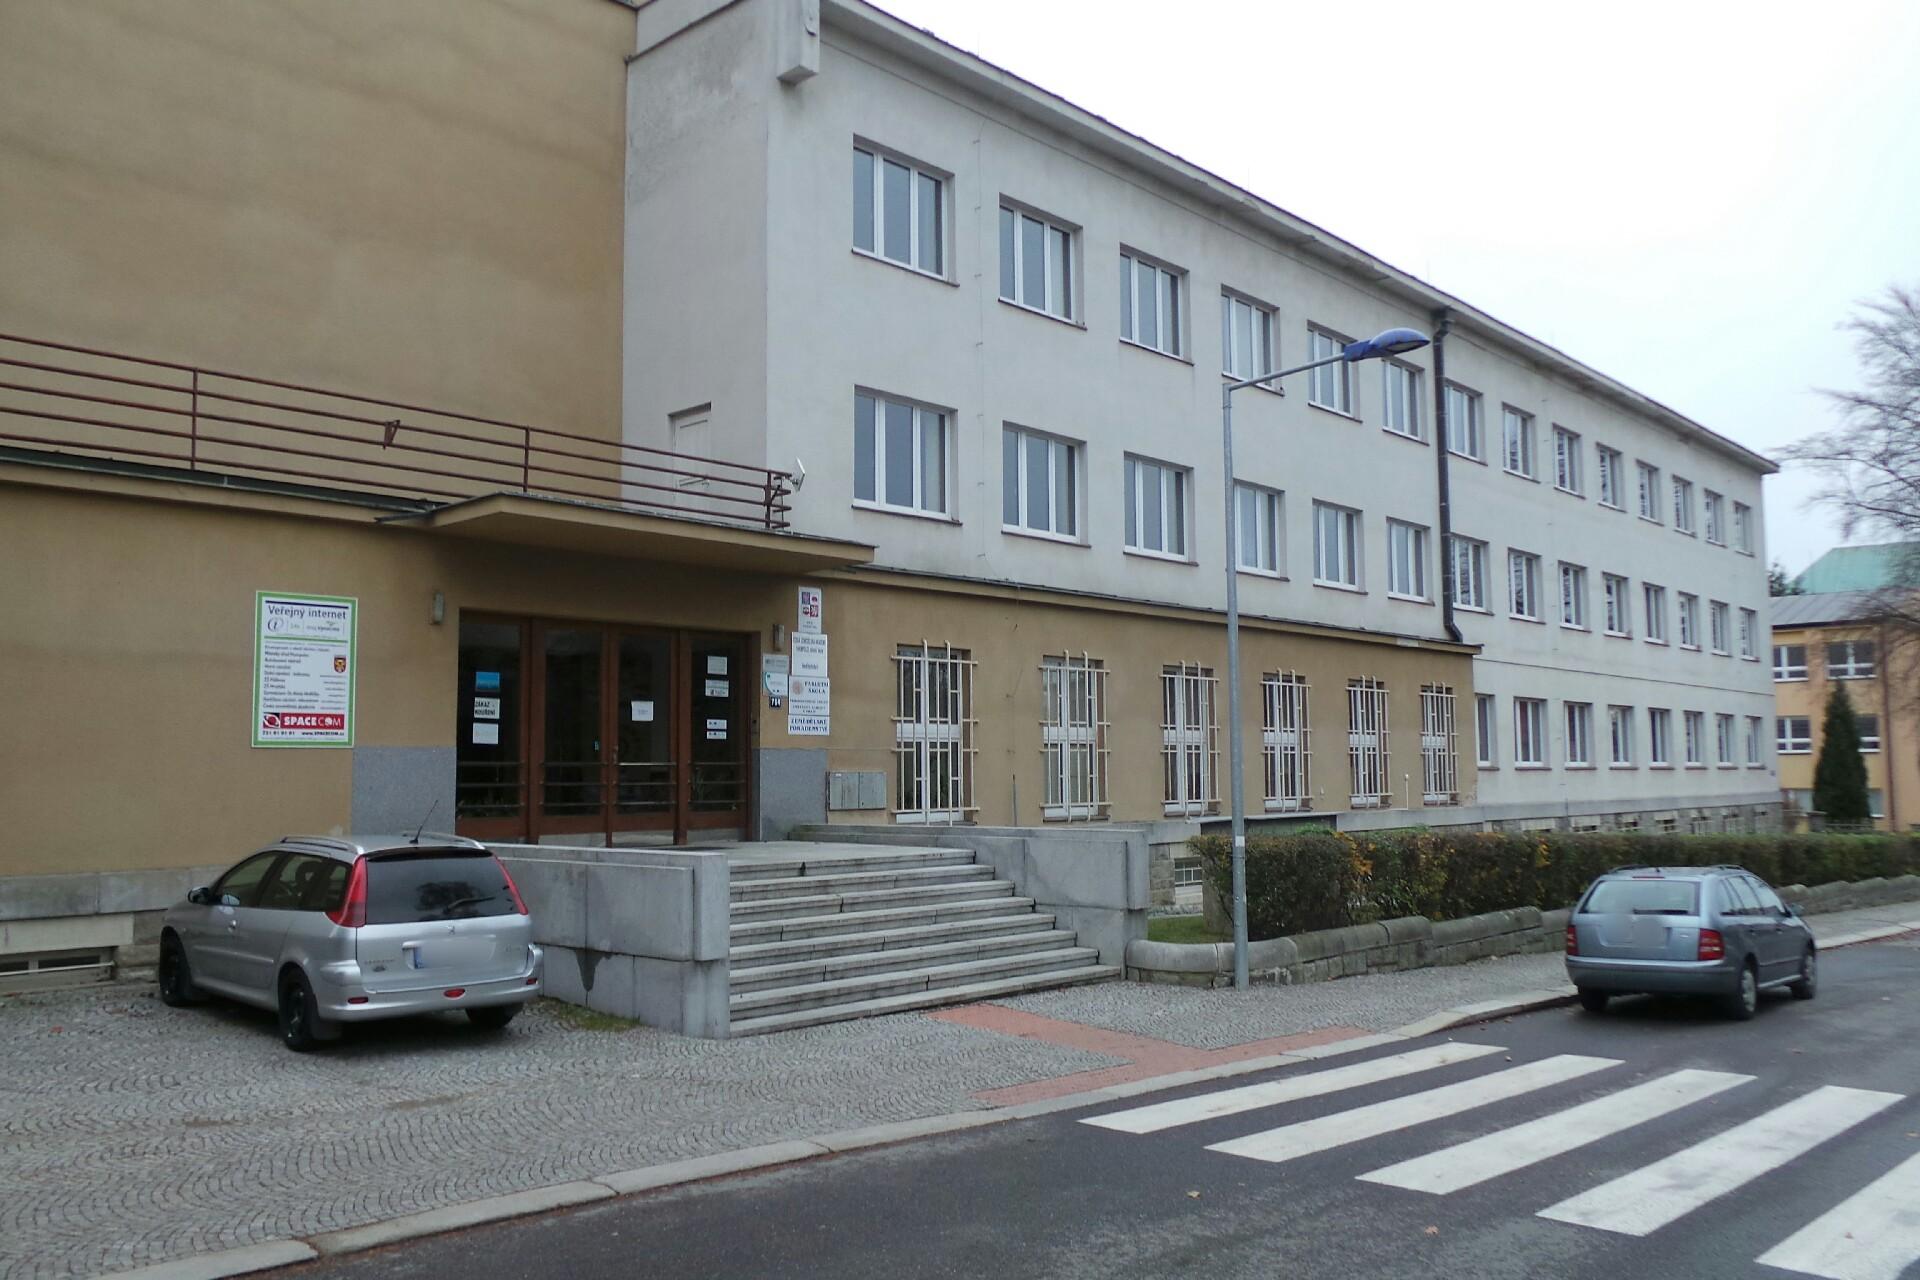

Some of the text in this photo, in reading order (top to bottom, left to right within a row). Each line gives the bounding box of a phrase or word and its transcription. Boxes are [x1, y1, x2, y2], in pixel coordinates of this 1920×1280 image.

[268, 605, 346, 619] Veřejný internet
[475, 700, 490, 708] ZÁKAZ
[284, 716, 341, 727] SPACECOM
